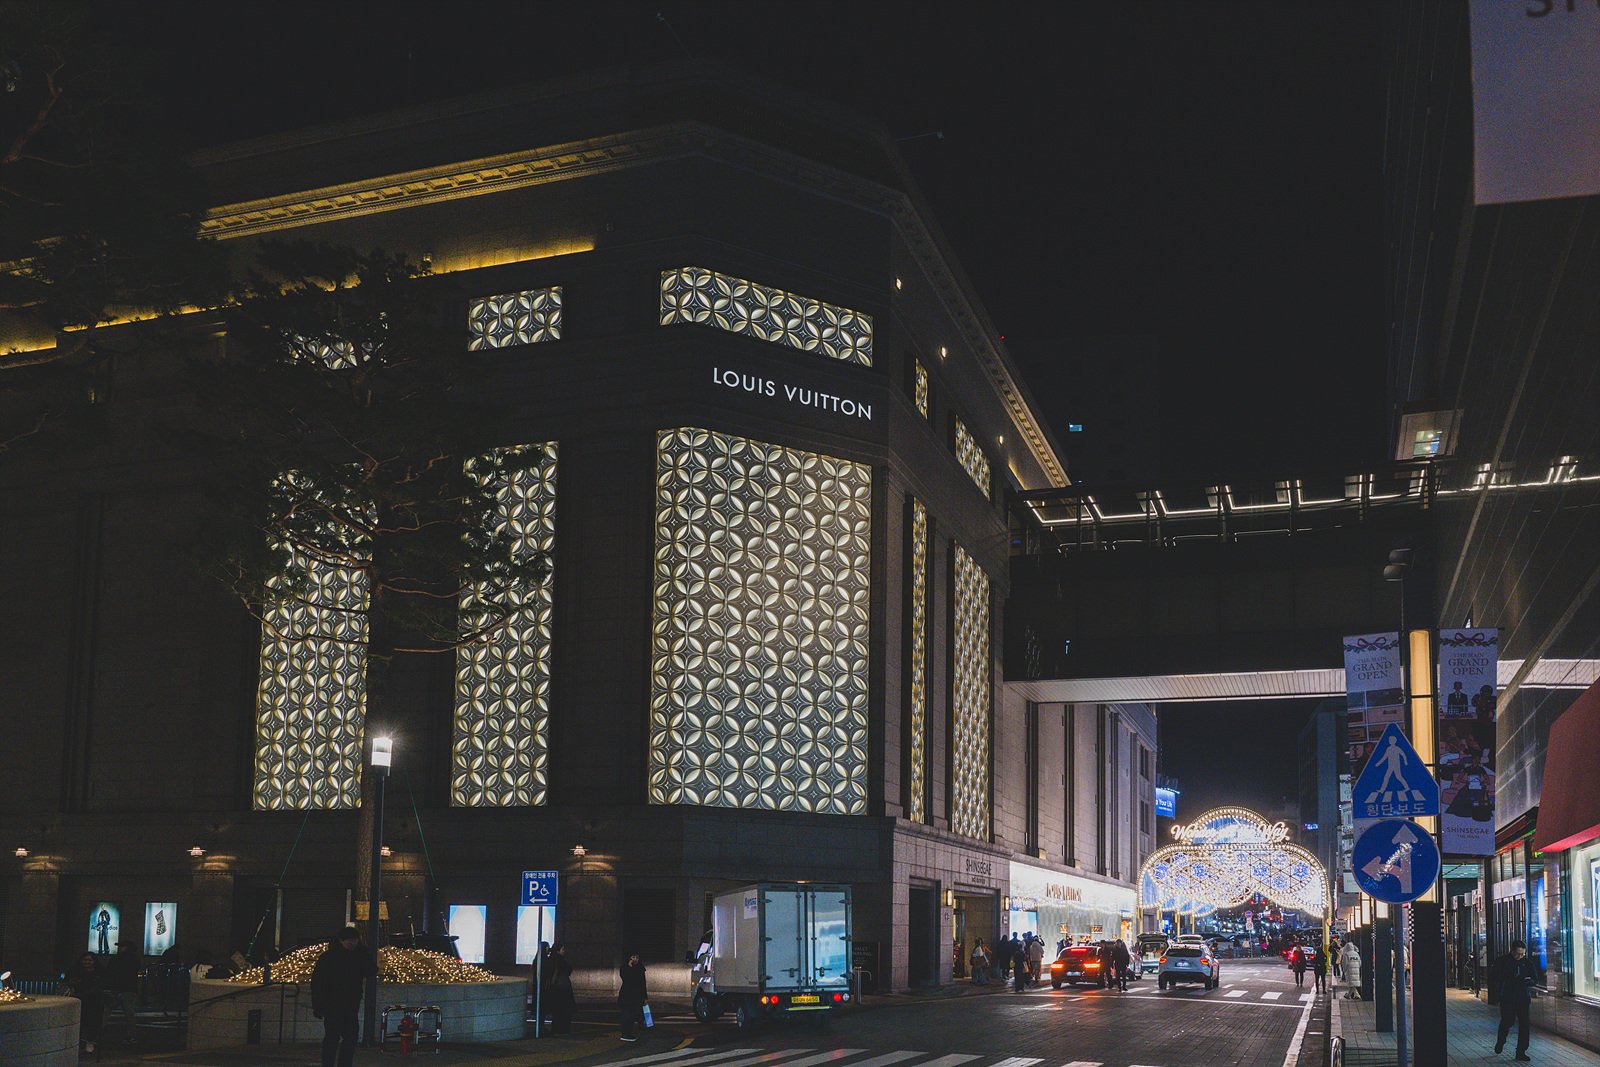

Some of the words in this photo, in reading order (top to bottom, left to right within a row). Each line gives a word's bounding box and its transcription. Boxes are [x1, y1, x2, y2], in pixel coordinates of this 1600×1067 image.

[713, 367, 776, 397] LOUIS
[783, 384, 872, 421] VUITTON
[1352, 661, 1393, 673] GRAND
[1448, 658, 1489, 667] GRAND
[1358, 669, 1389, 681] OPEN
[1452, 667, 1484, 676] OPEN
[1366, 802, 1426, 817] 횡단보도
[1446, 826, 1490, 835] SHINSEGAE
[965, 858, 992, 876] SHINSEGAE
[529, 881, 539, 896] P
